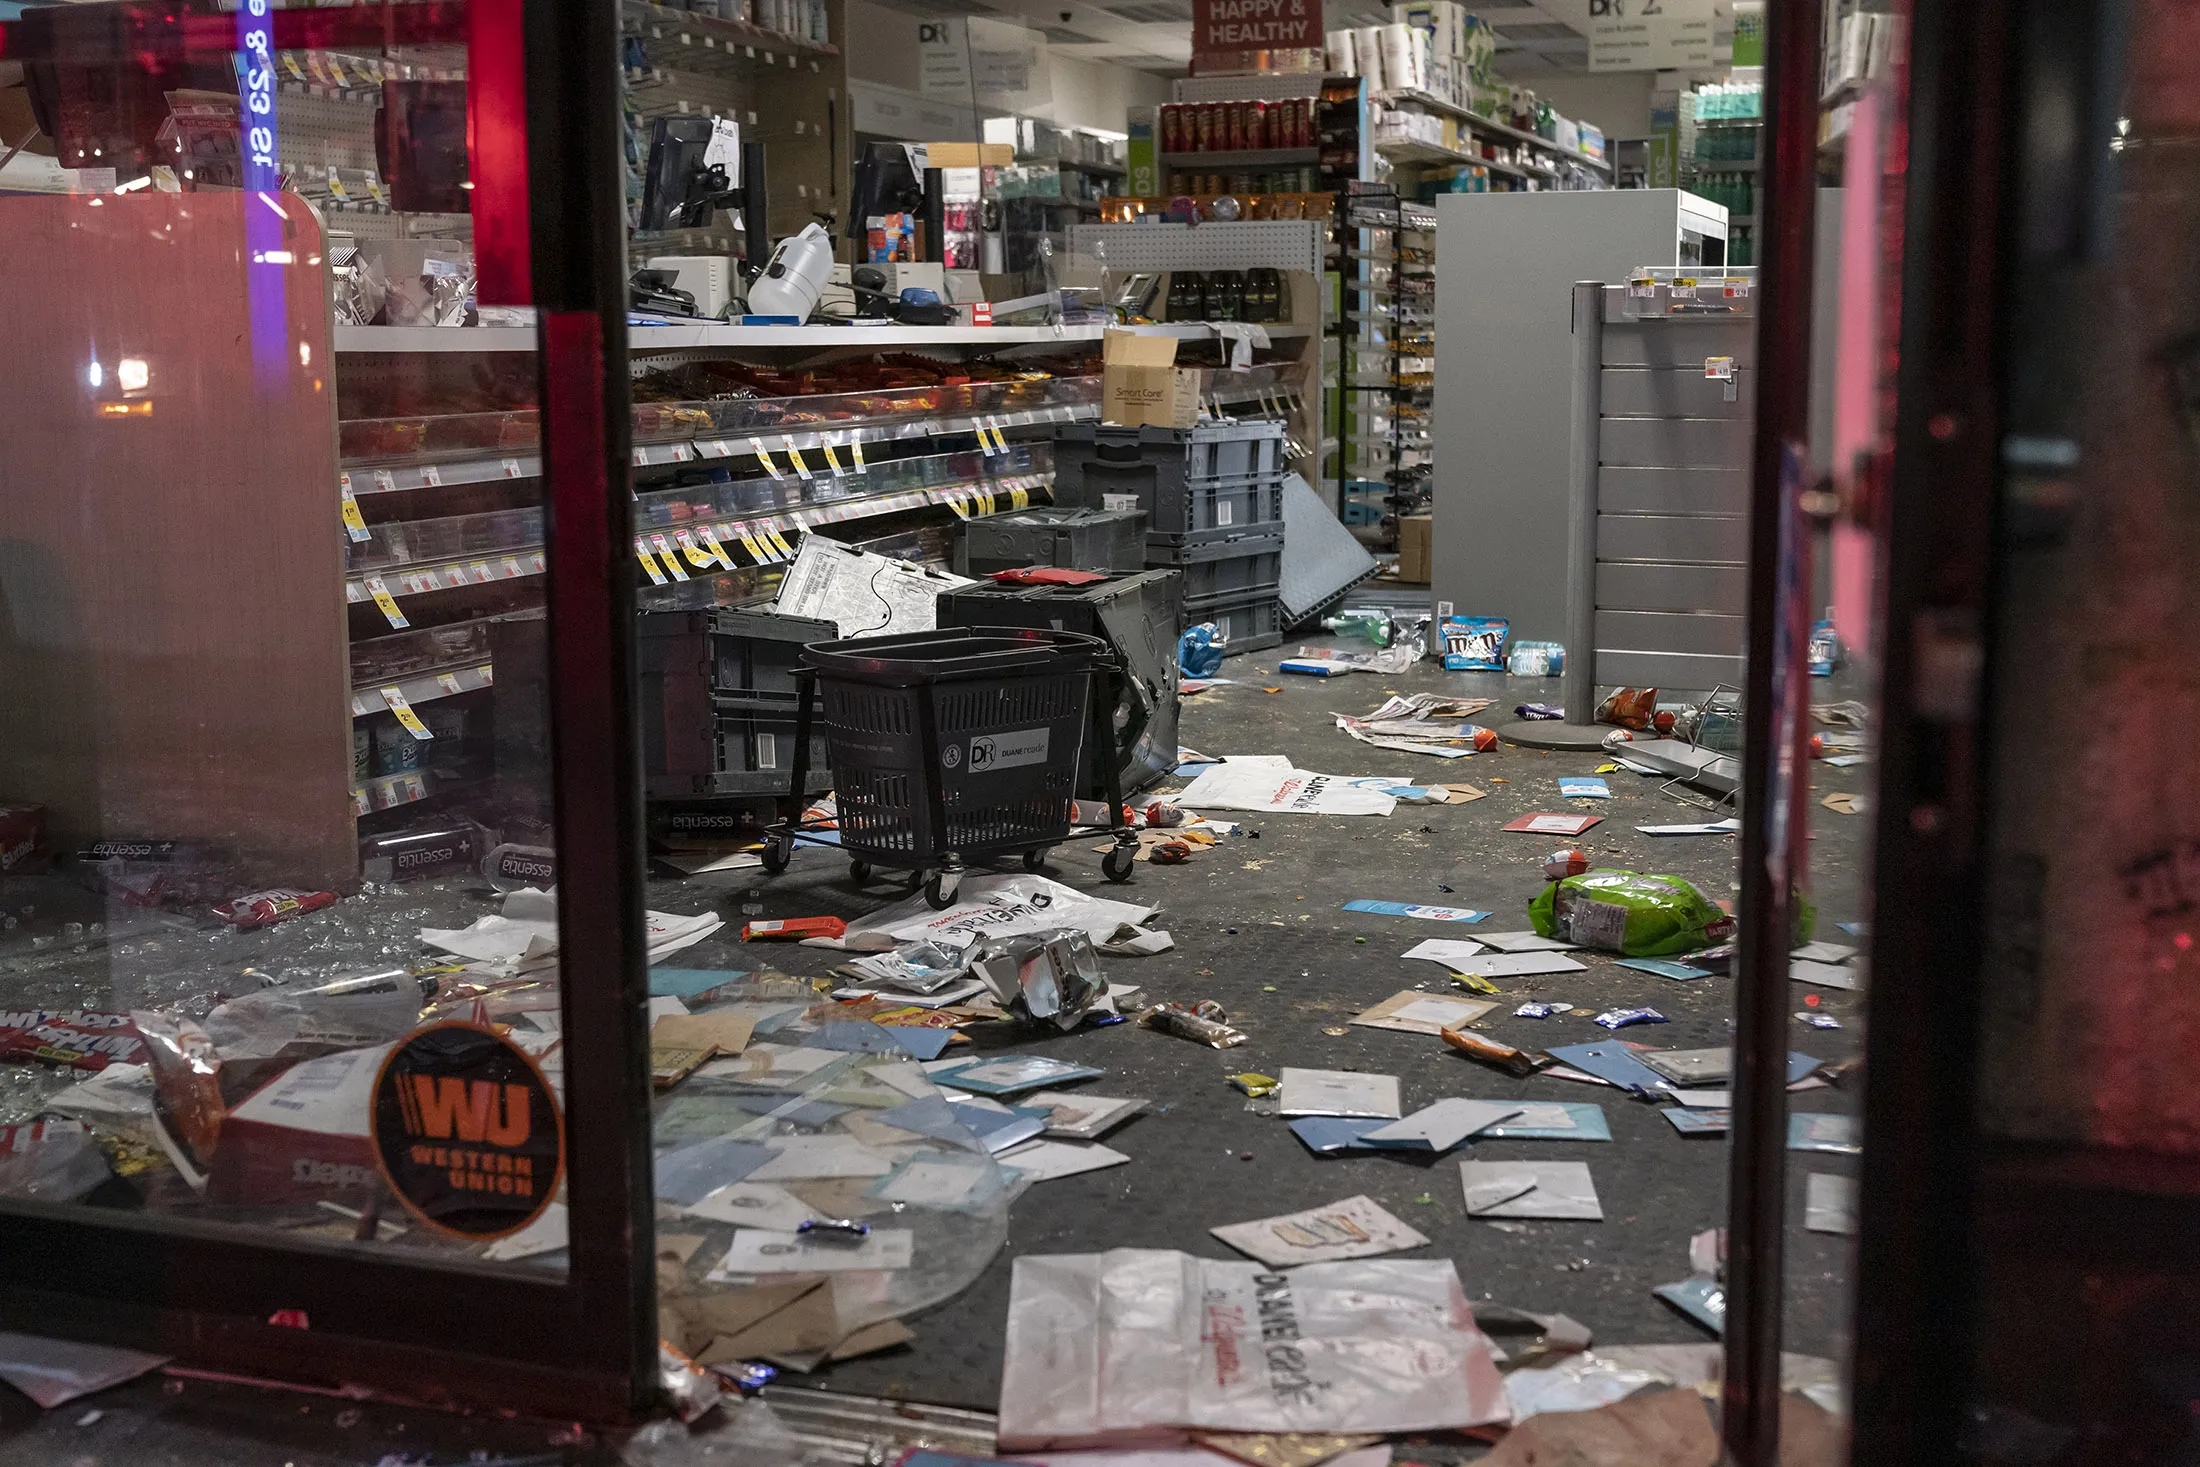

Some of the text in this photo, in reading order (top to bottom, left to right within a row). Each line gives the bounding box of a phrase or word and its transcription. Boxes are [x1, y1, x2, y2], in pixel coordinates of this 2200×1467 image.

[1209, 0, 1306, 20] HAPPY &
[919, 23, 949, 44] DR
[1208, 20, 1309, 45] HEALTHY
[971, 743, 994, 764] DR
[672, 815, 734, 830] essentia
[398, 848, 453, 868] essentia
[502, 860, 552, 877] essentia
[412, 1073, 531, 1148] WU
[410, 1144, 533, 1176] WESTERN
[449, 1168, 534, 1197] UNION
